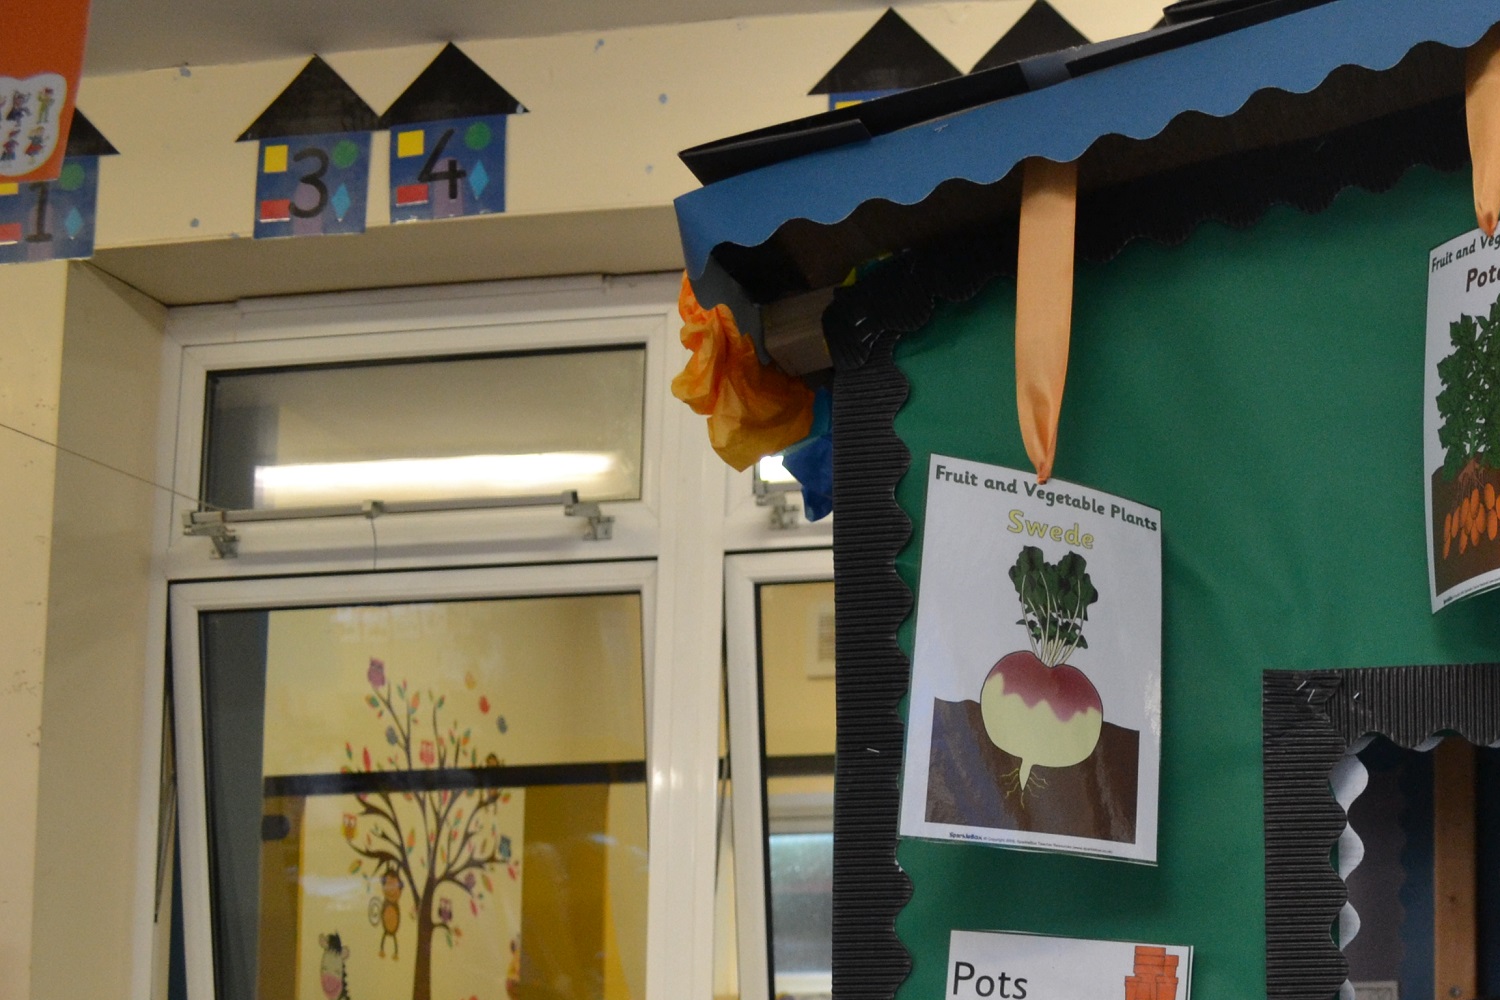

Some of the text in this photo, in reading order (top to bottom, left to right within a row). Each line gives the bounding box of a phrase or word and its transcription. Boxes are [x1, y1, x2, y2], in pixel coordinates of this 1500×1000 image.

[289, 147, 330, 218] 3
[418, 128, 466, 199] 4
[1431, 252, 1453, 273] Fruit
[1456, 239, 1476, 261] and
[935, 464, 1158, 531] Fruit and Vegetable Plants
[1007, 509, 1095, 549] Swede
[953, 961, 1028, 1000] Pots
